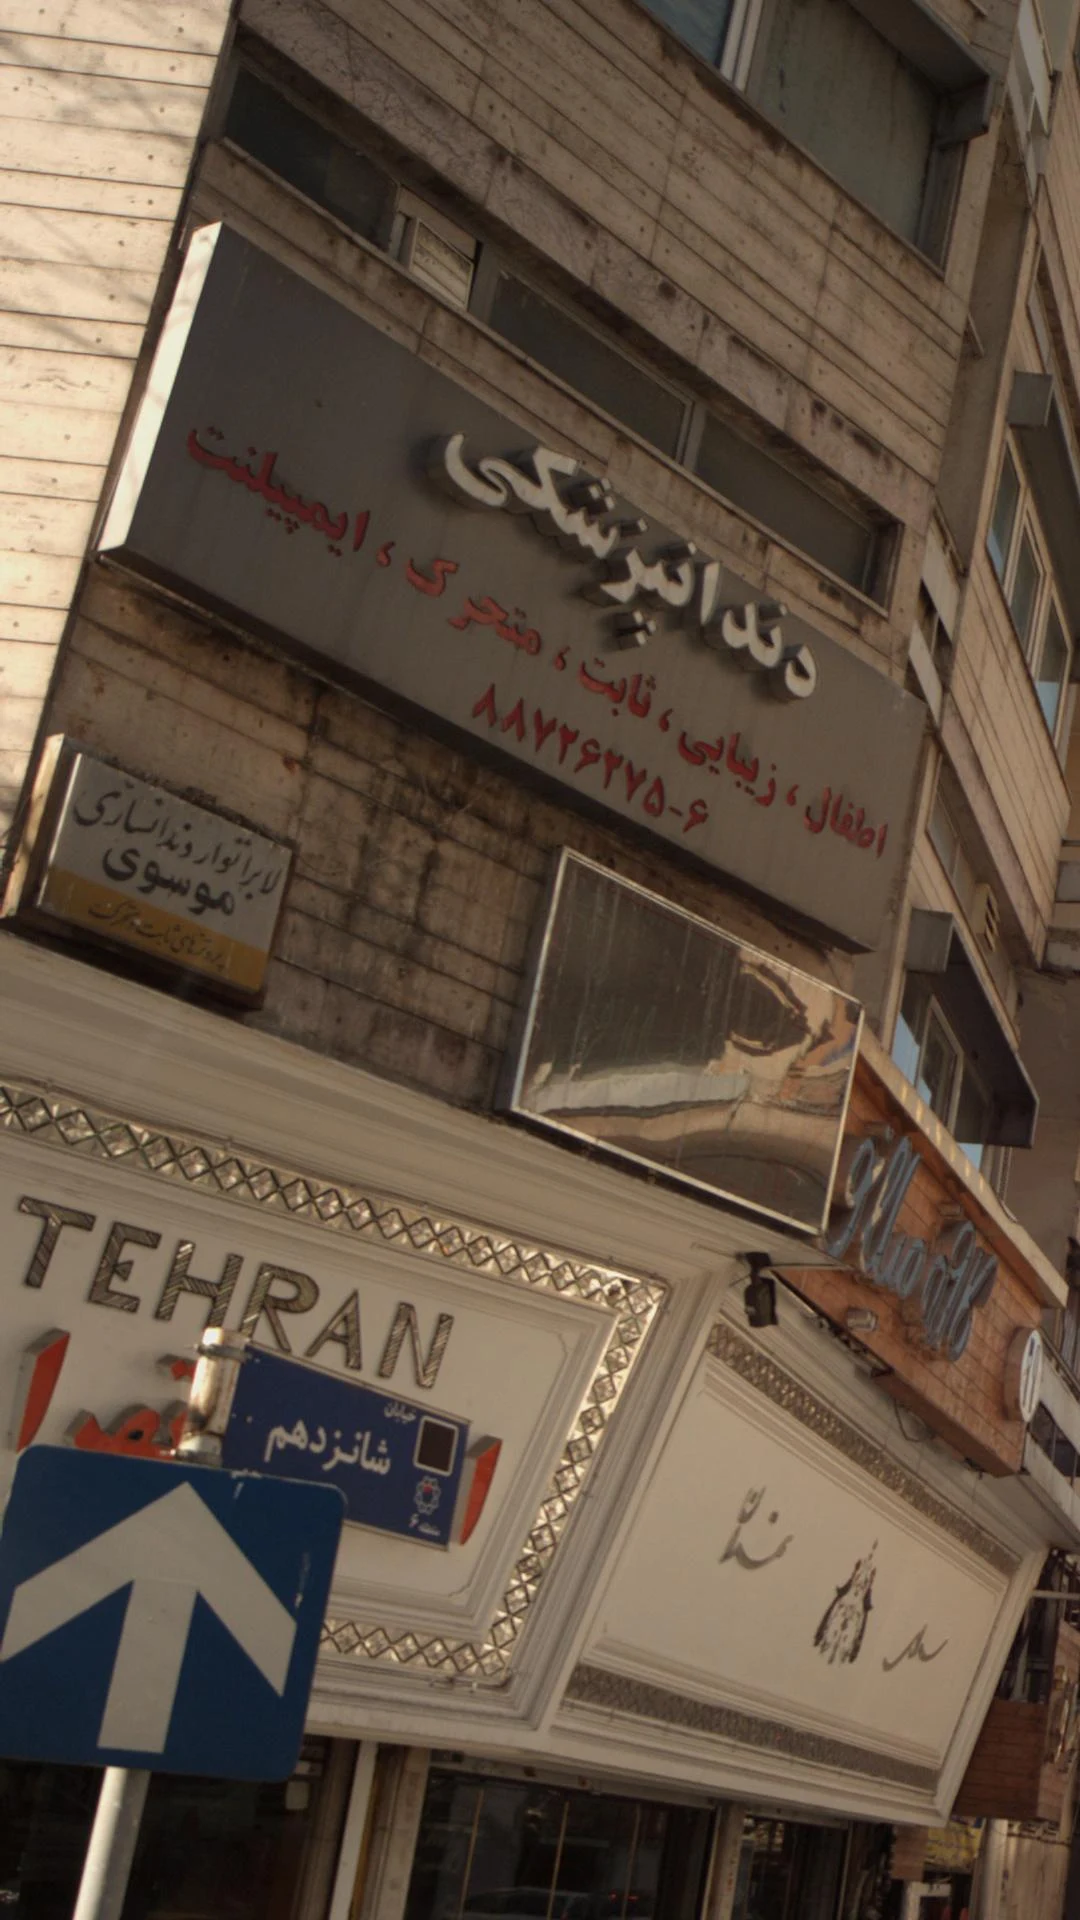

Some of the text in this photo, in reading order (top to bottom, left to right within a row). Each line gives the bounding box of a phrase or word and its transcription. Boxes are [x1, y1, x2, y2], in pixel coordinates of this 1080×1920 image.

[445, 433, 817, 698] دندانپزشکی
[73, 781, 283, 900] لابراتوار دندانسازی
[103, 848, 236, 916] موسوی
[18, 1195, 455, 1390] TEHRAN
[264, 1418, 391, 1476] شانزدهم
[383, 1402, 417, 1424] خیابان
